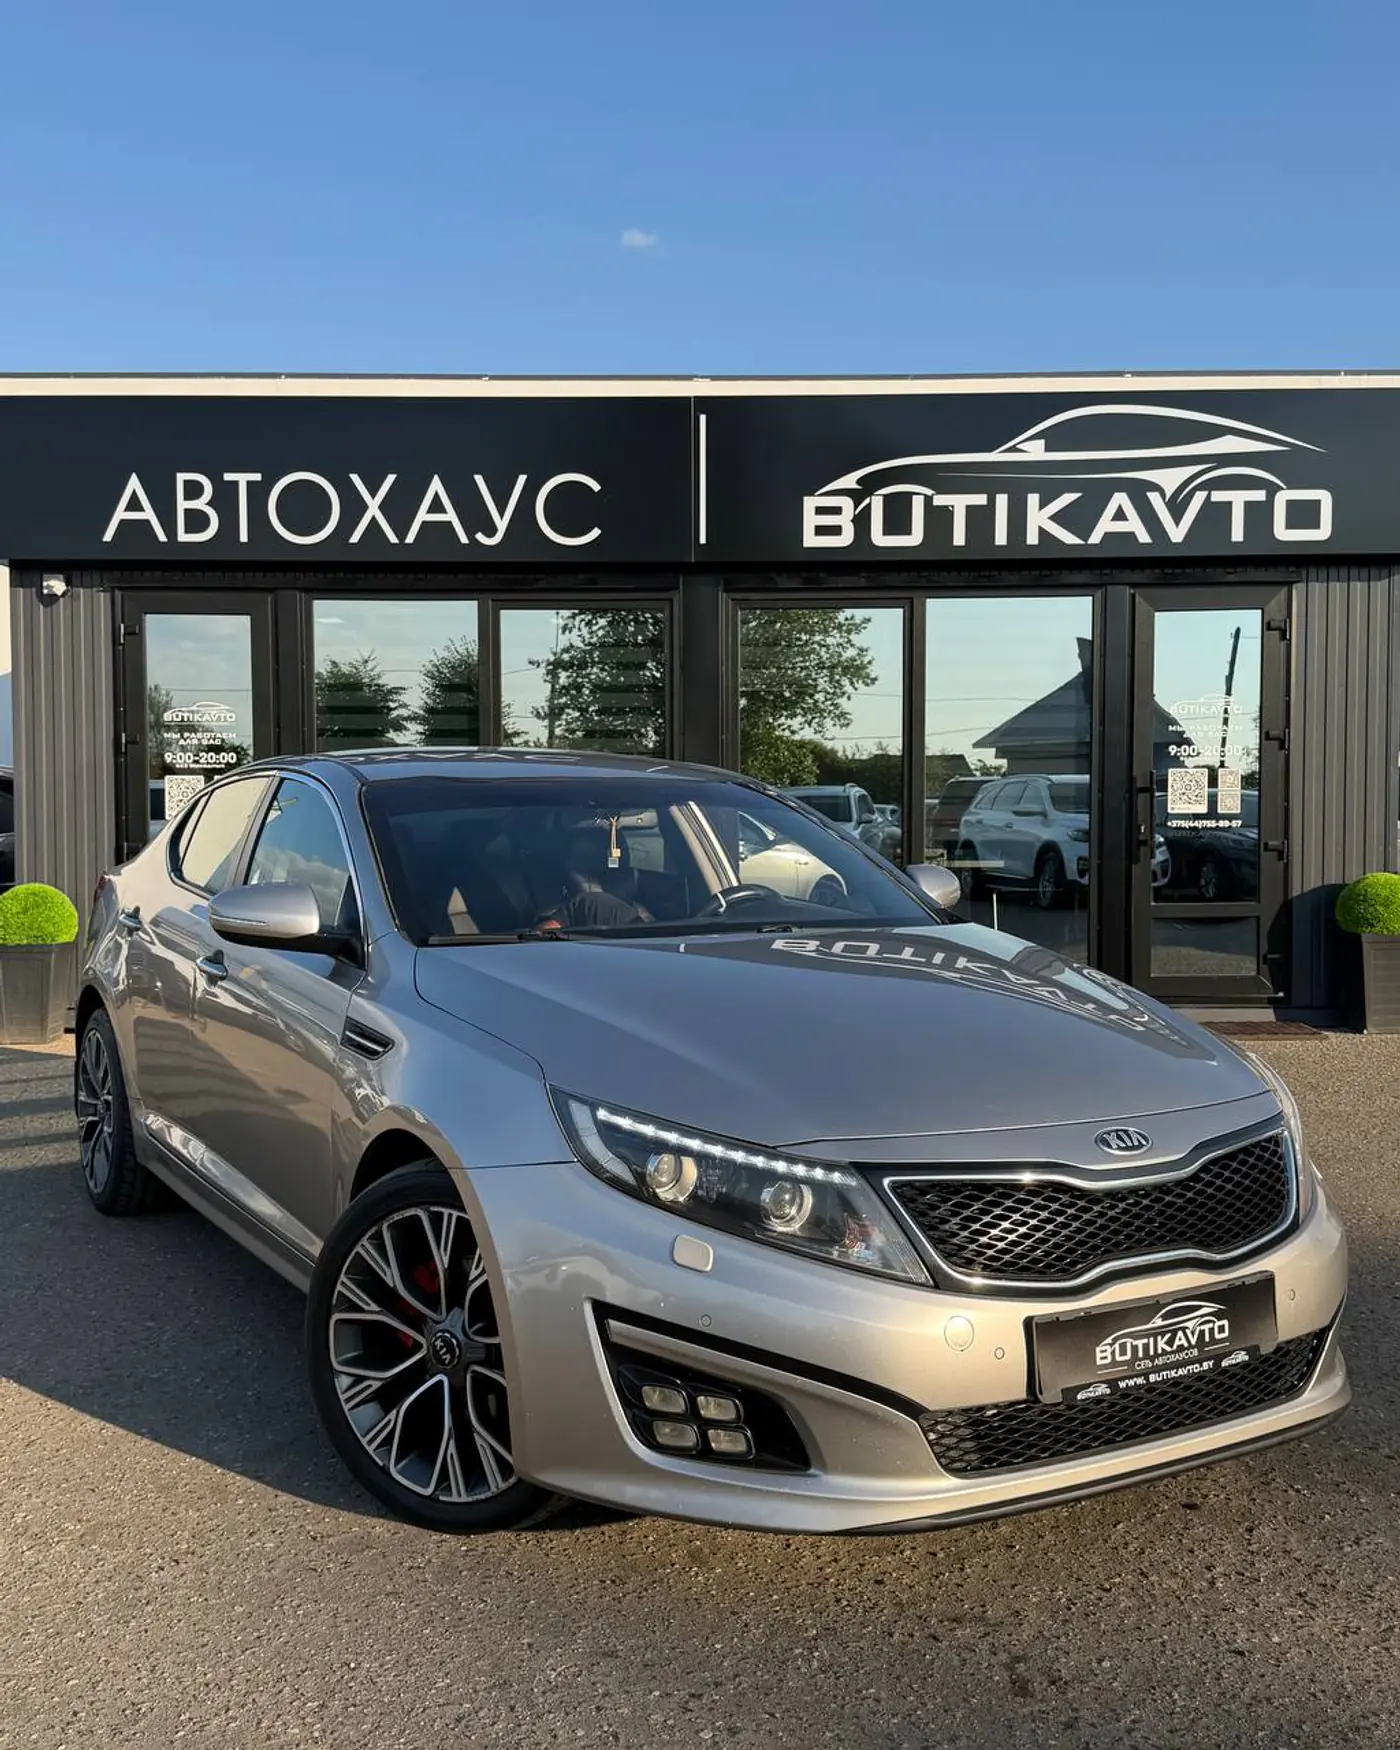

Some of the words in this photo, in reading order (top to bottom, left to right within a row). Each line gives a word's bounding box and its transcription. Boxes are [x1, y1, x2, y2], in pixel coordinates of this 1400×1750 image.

[102, 471, 602, 545] АВТОХАУС
[802, 488, 1333, 548] BUTIKAVTO
[164, 752, 237, 764] 9:00-20:00
[1103, 1130, 1147, 1149] KIA
[434, 1338, 451, 1364] KIA
[1096, 1320, 1229, 1366] BUTIKAVTO
[1134, 1360, 1153, 1370] СЕТЬ
[1149, 1360, 1214, 1383] BUTIKAVTO.BY
